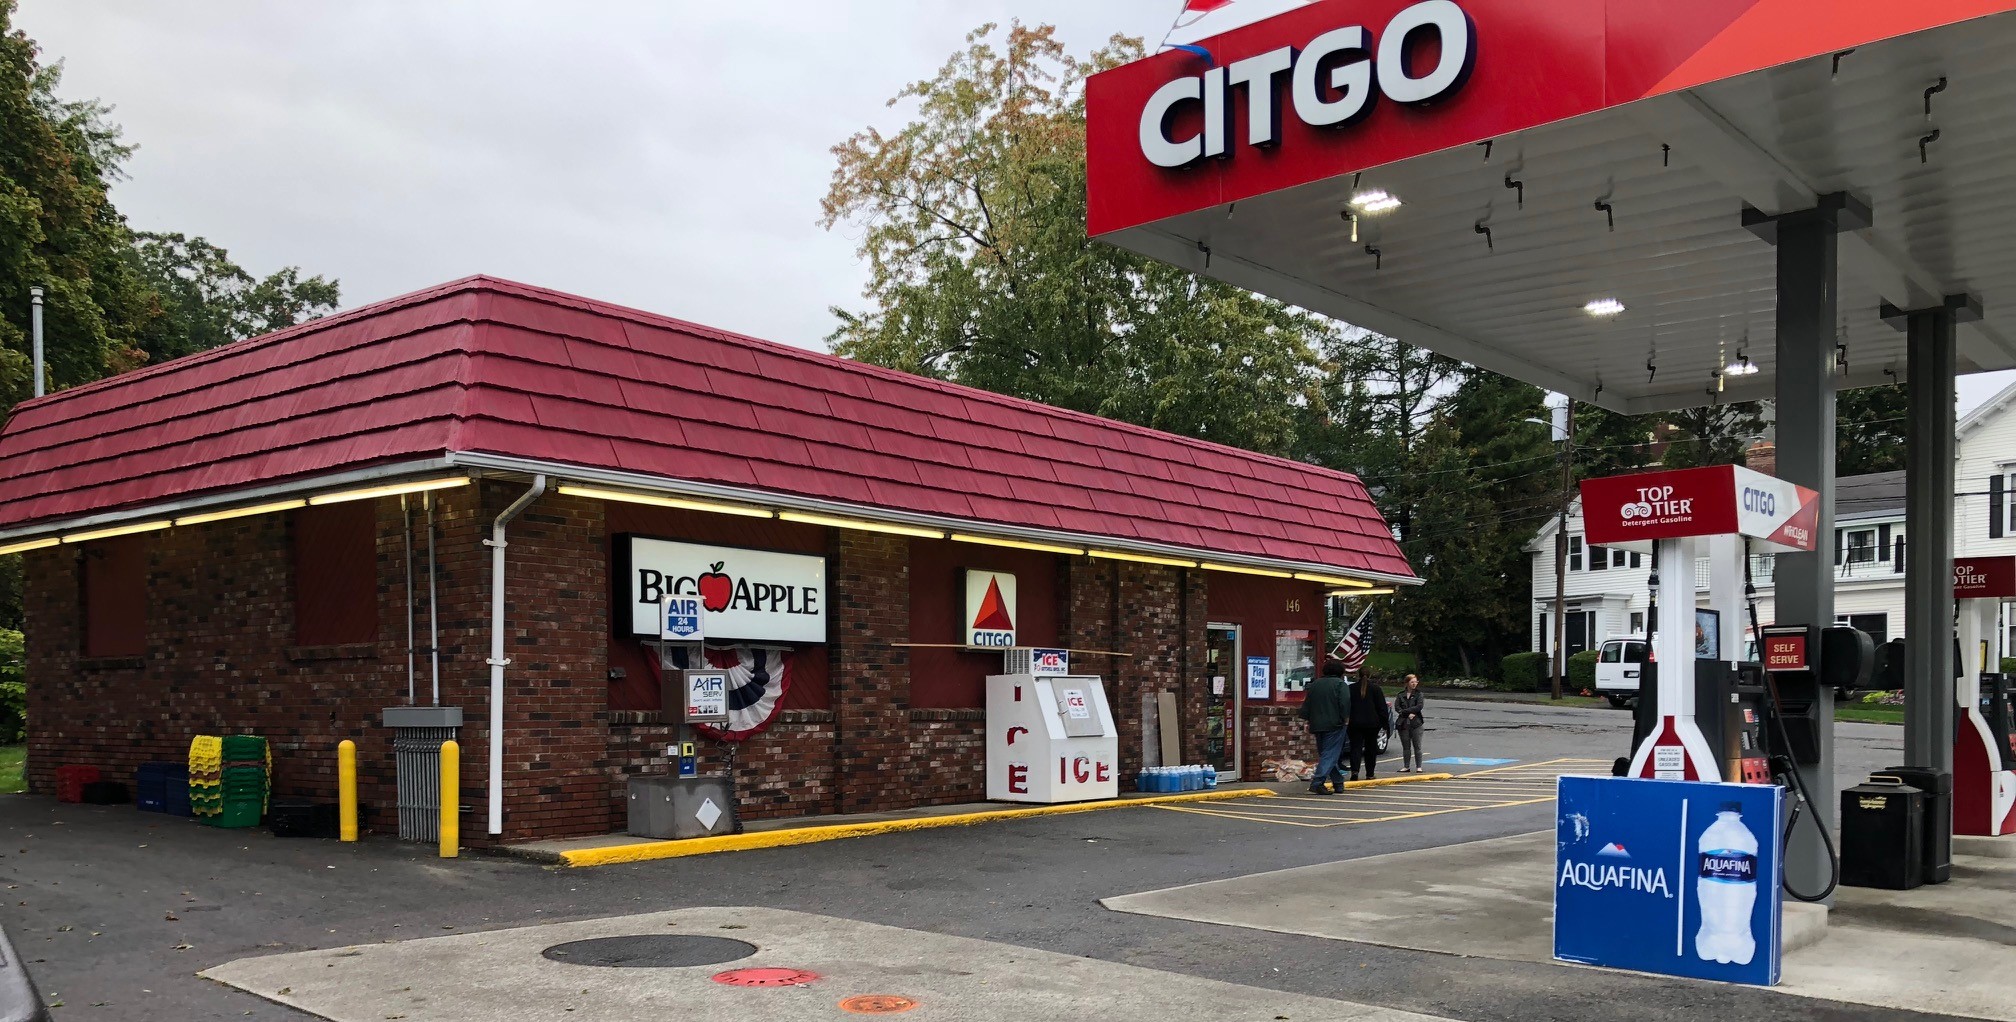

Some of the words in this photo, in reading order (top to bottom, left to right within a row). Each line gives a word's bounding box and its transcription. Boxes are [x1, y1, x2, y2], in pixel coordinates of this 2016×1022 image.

[1139, 0, 1472, 168] CITGO
[1636, 486, 1674, 502] TOP
[1652, 499, 1693, 516] TIER
[1743, 487, 1775, 517] CITGO
[1622, 518, 1658, 527] Detergent
[1660, 516, 1693, 524] Gasoline
[1954, 566, 1974, 575] OP
[1959, 574, 1986, 584] TIER
[638, 569, 698, 604] BIG
[731, 577, 819, 615] APPLE
[668, 599, 698, 615] AIR
[1285, 598, 1300, 612] 146
[677, 617, 688, 625] 24
[973, 631, 1013, 646] CITGO
[1773, 643, 1796, 653] SELF
[1042, 654, 1059, 666] ICE
[1770, 655, 1799, 664] SERVE
[1252, 665, 1265, 678] Play
[1251, 677, 1267, 688] Here!
[1067, 697, 1084, 706] ICE
[1060, 755, 1110, 784] ICE
[1703, 858, 1751, 875] AQUAFINA
[1559, 859, 1671, 898] AQUAFINA
